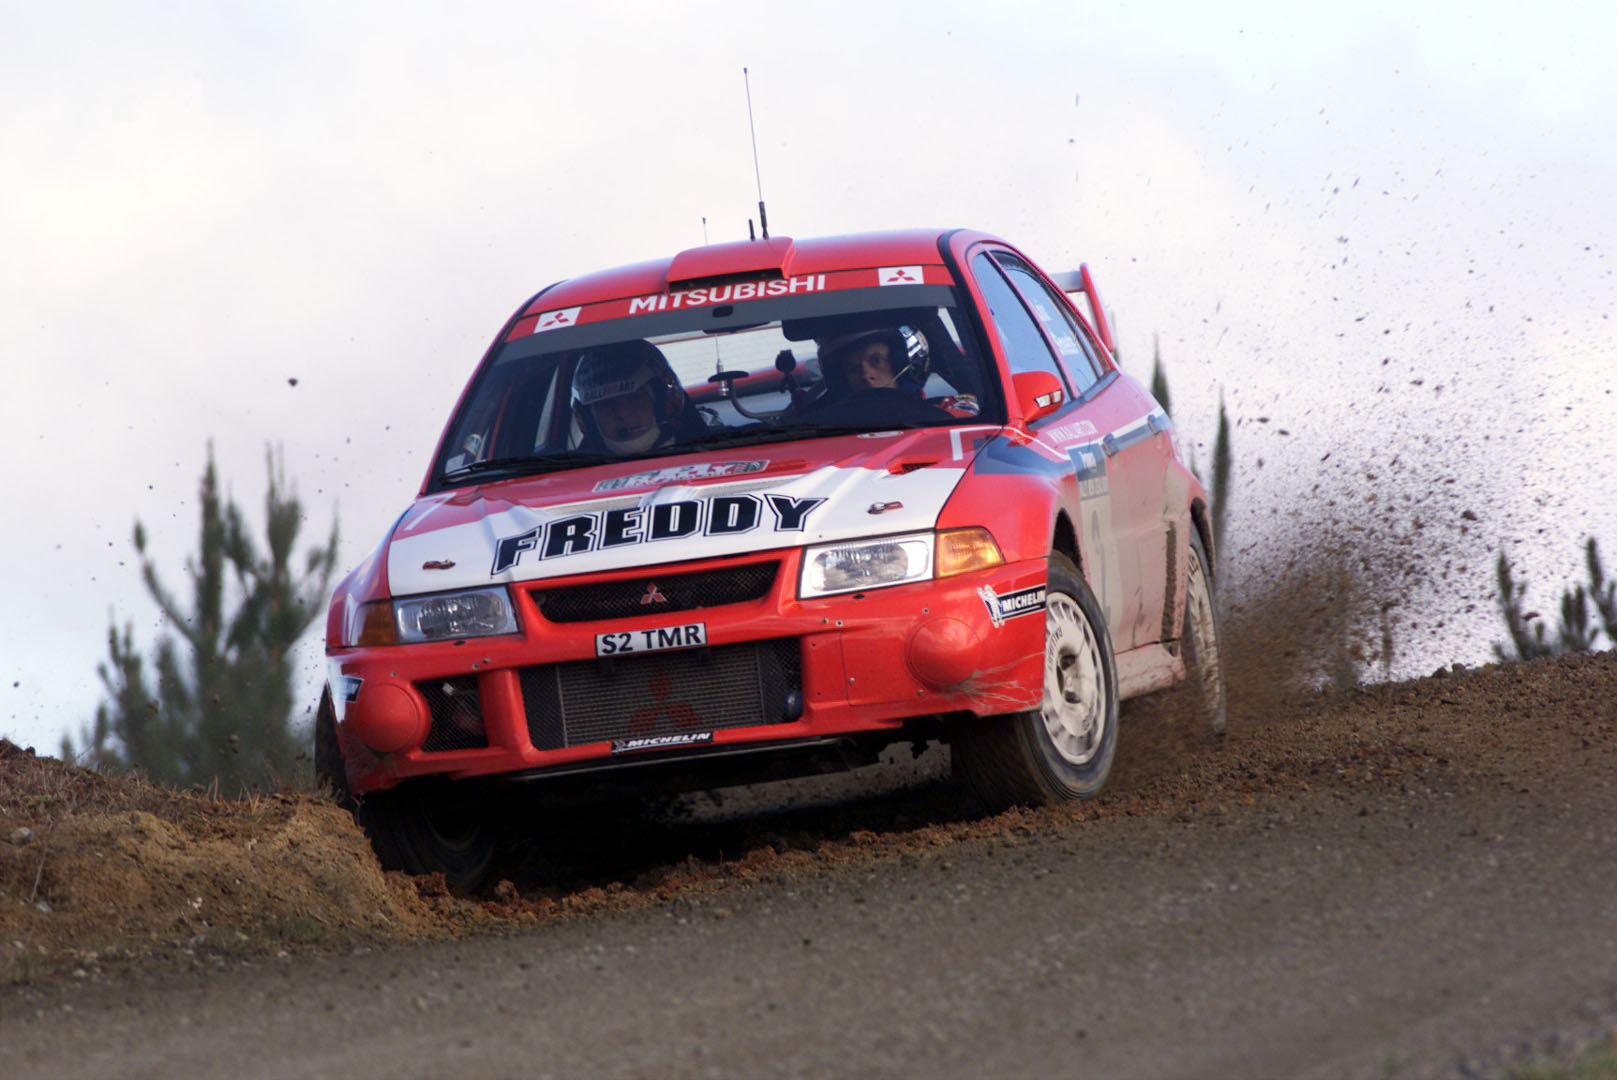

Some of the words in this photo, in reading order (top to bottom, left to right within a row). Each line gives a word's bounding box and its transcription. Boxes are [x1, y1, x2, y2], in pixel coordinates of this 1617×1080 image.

[629, 275, 826, 314] MITSUBISHI
[491, 493, 828, 576] FREDDY
[1002, 590, 1046, 612] MICHELIN
[601, 632, 634, 654] S2
[641, 624, 702, 649] TMR
[627, 732, 711, 748] MICHELIN
